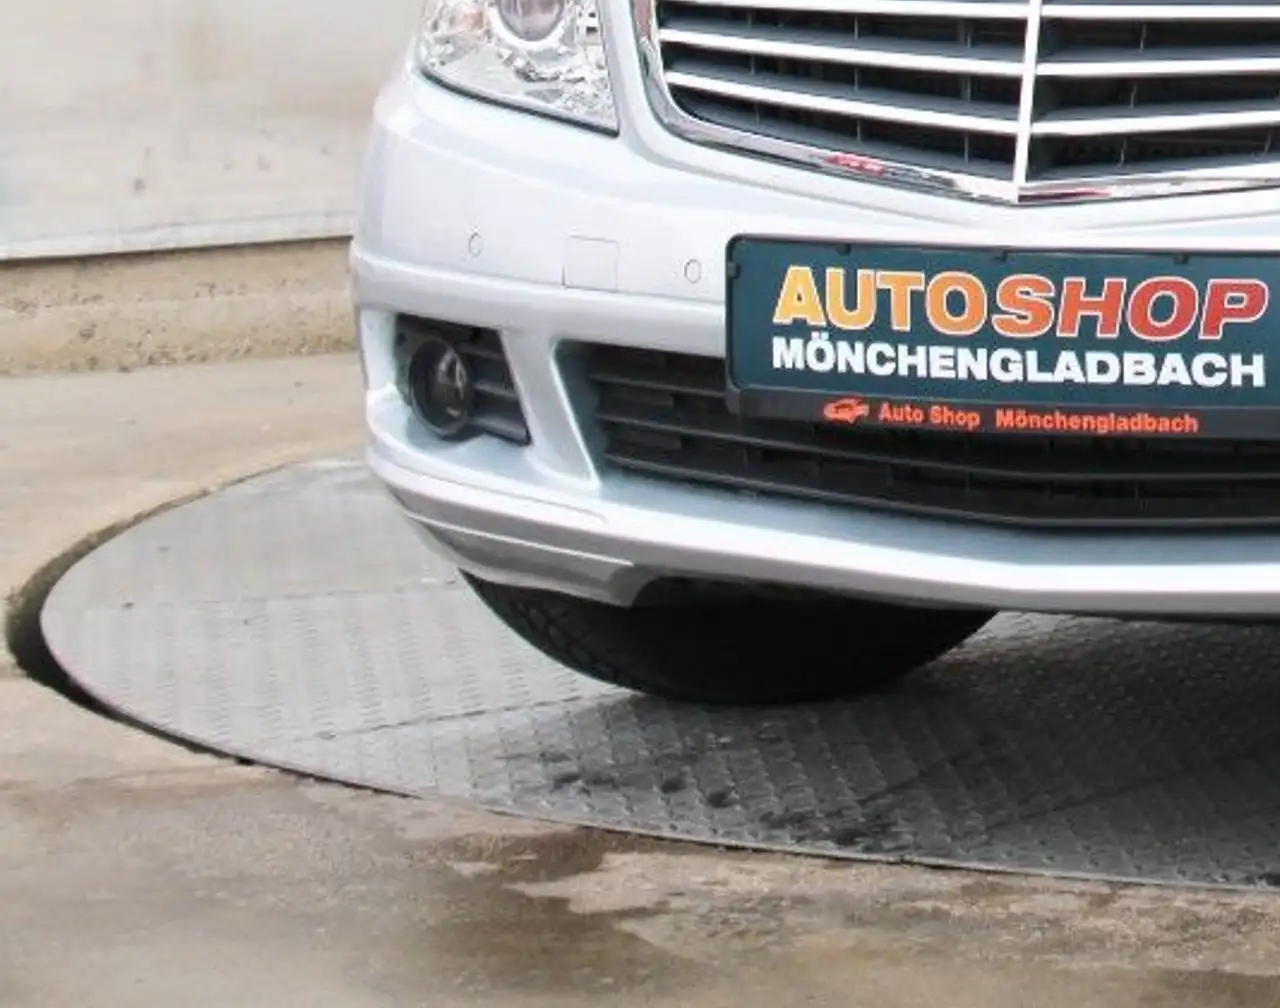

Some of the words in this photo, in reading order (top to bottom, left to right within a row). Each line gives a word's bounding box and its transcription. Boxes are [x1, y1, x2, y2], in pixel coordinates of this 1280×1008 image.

[772, 265, 1270, 342] AUTOSHOP
[772, 331, 1266, 388] MÖNCHENGLADBACH
[878, 401, 924, 423] Auto
[929, 403, 981, 430] Shop
[995, 407, 1199, 434] Mönchengladbach
